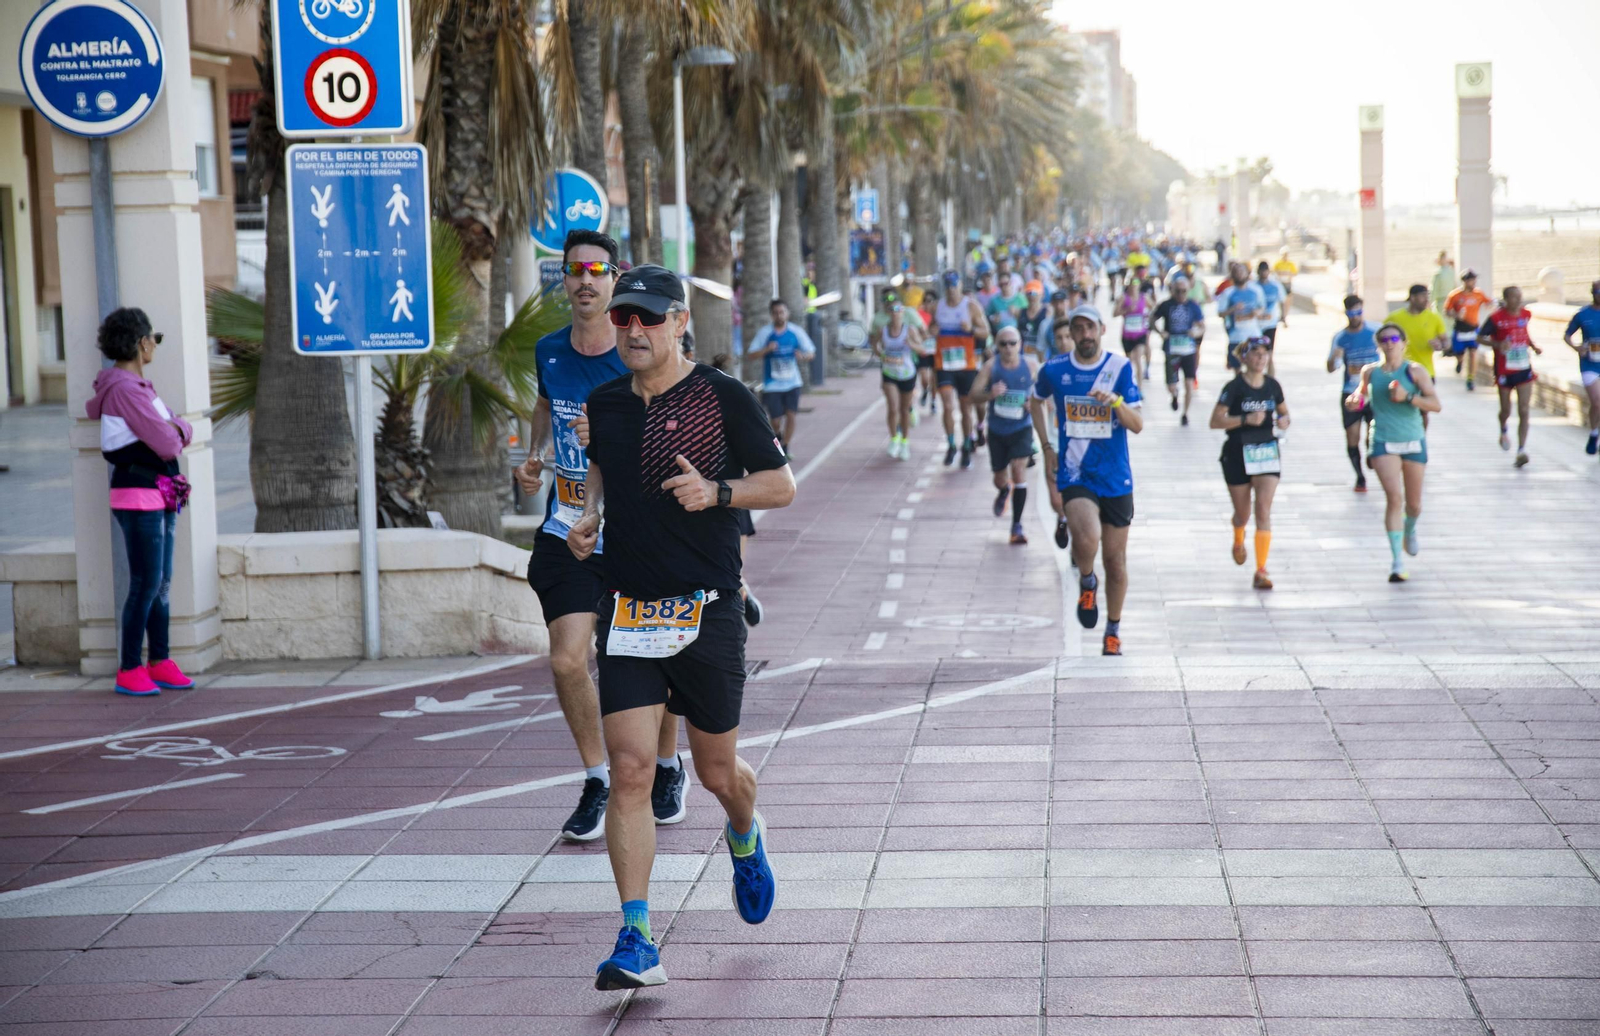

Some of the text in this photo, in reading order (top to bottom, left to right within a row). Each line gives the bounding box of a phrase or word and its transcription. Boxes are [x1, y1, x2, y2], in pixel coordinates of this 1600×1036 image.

[47, 36, 133, 58] ALMERÍA
[40, 58, 142, 72] CONTRA EL MALTRATO
[56, 71, 127, 82] TOLERANCIA CERO
[323, 71, 361, 103] 10
[295, 150, 419, 161] POR EL BIEN DE TODOS
[354, 249, 369, 257] 2m
[315, 333, 346, 341] ALMERÍA
[370, 332, 399, 340] GRACIAS
[371, 338, 424, 347] COLABORACIÓN
[625, 600, 696, 621] 1582
